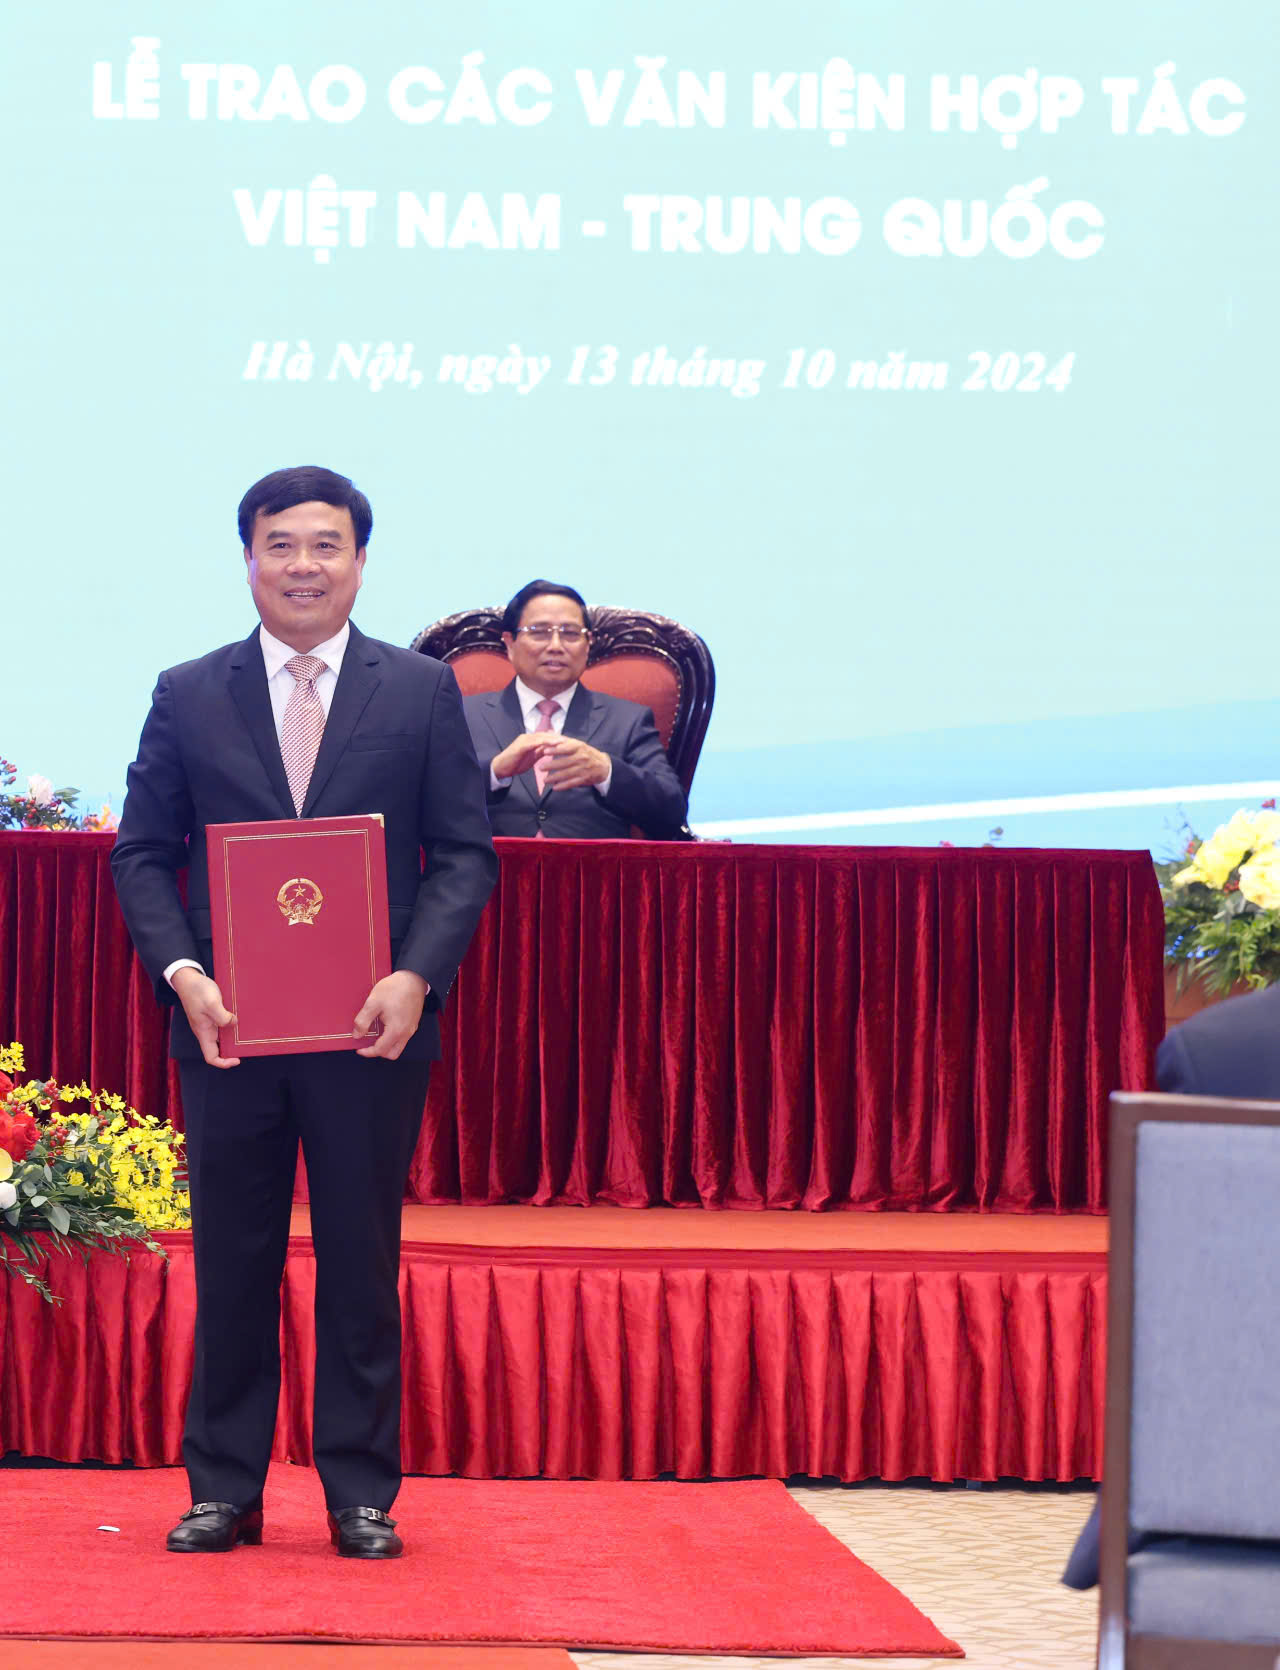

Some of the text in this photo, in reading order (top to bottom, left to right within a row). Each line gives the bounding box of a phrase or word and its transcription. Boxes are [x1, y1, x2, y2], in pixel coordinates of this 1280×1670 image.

[92, 36, 1246, 150] LỄ TRAO CÁC VĂN KIỆN HỢP TÁC
[232, 173, 377, 264] VIỆT
[397, 190, 561, 249] NAM
[623, 193, 862, 256] TRUNG
[883, 175, 1105, 260] QUỐC
[242, 338, 1075, 398] Hà Nội, ngày 13 tháng 10 năm 2024
